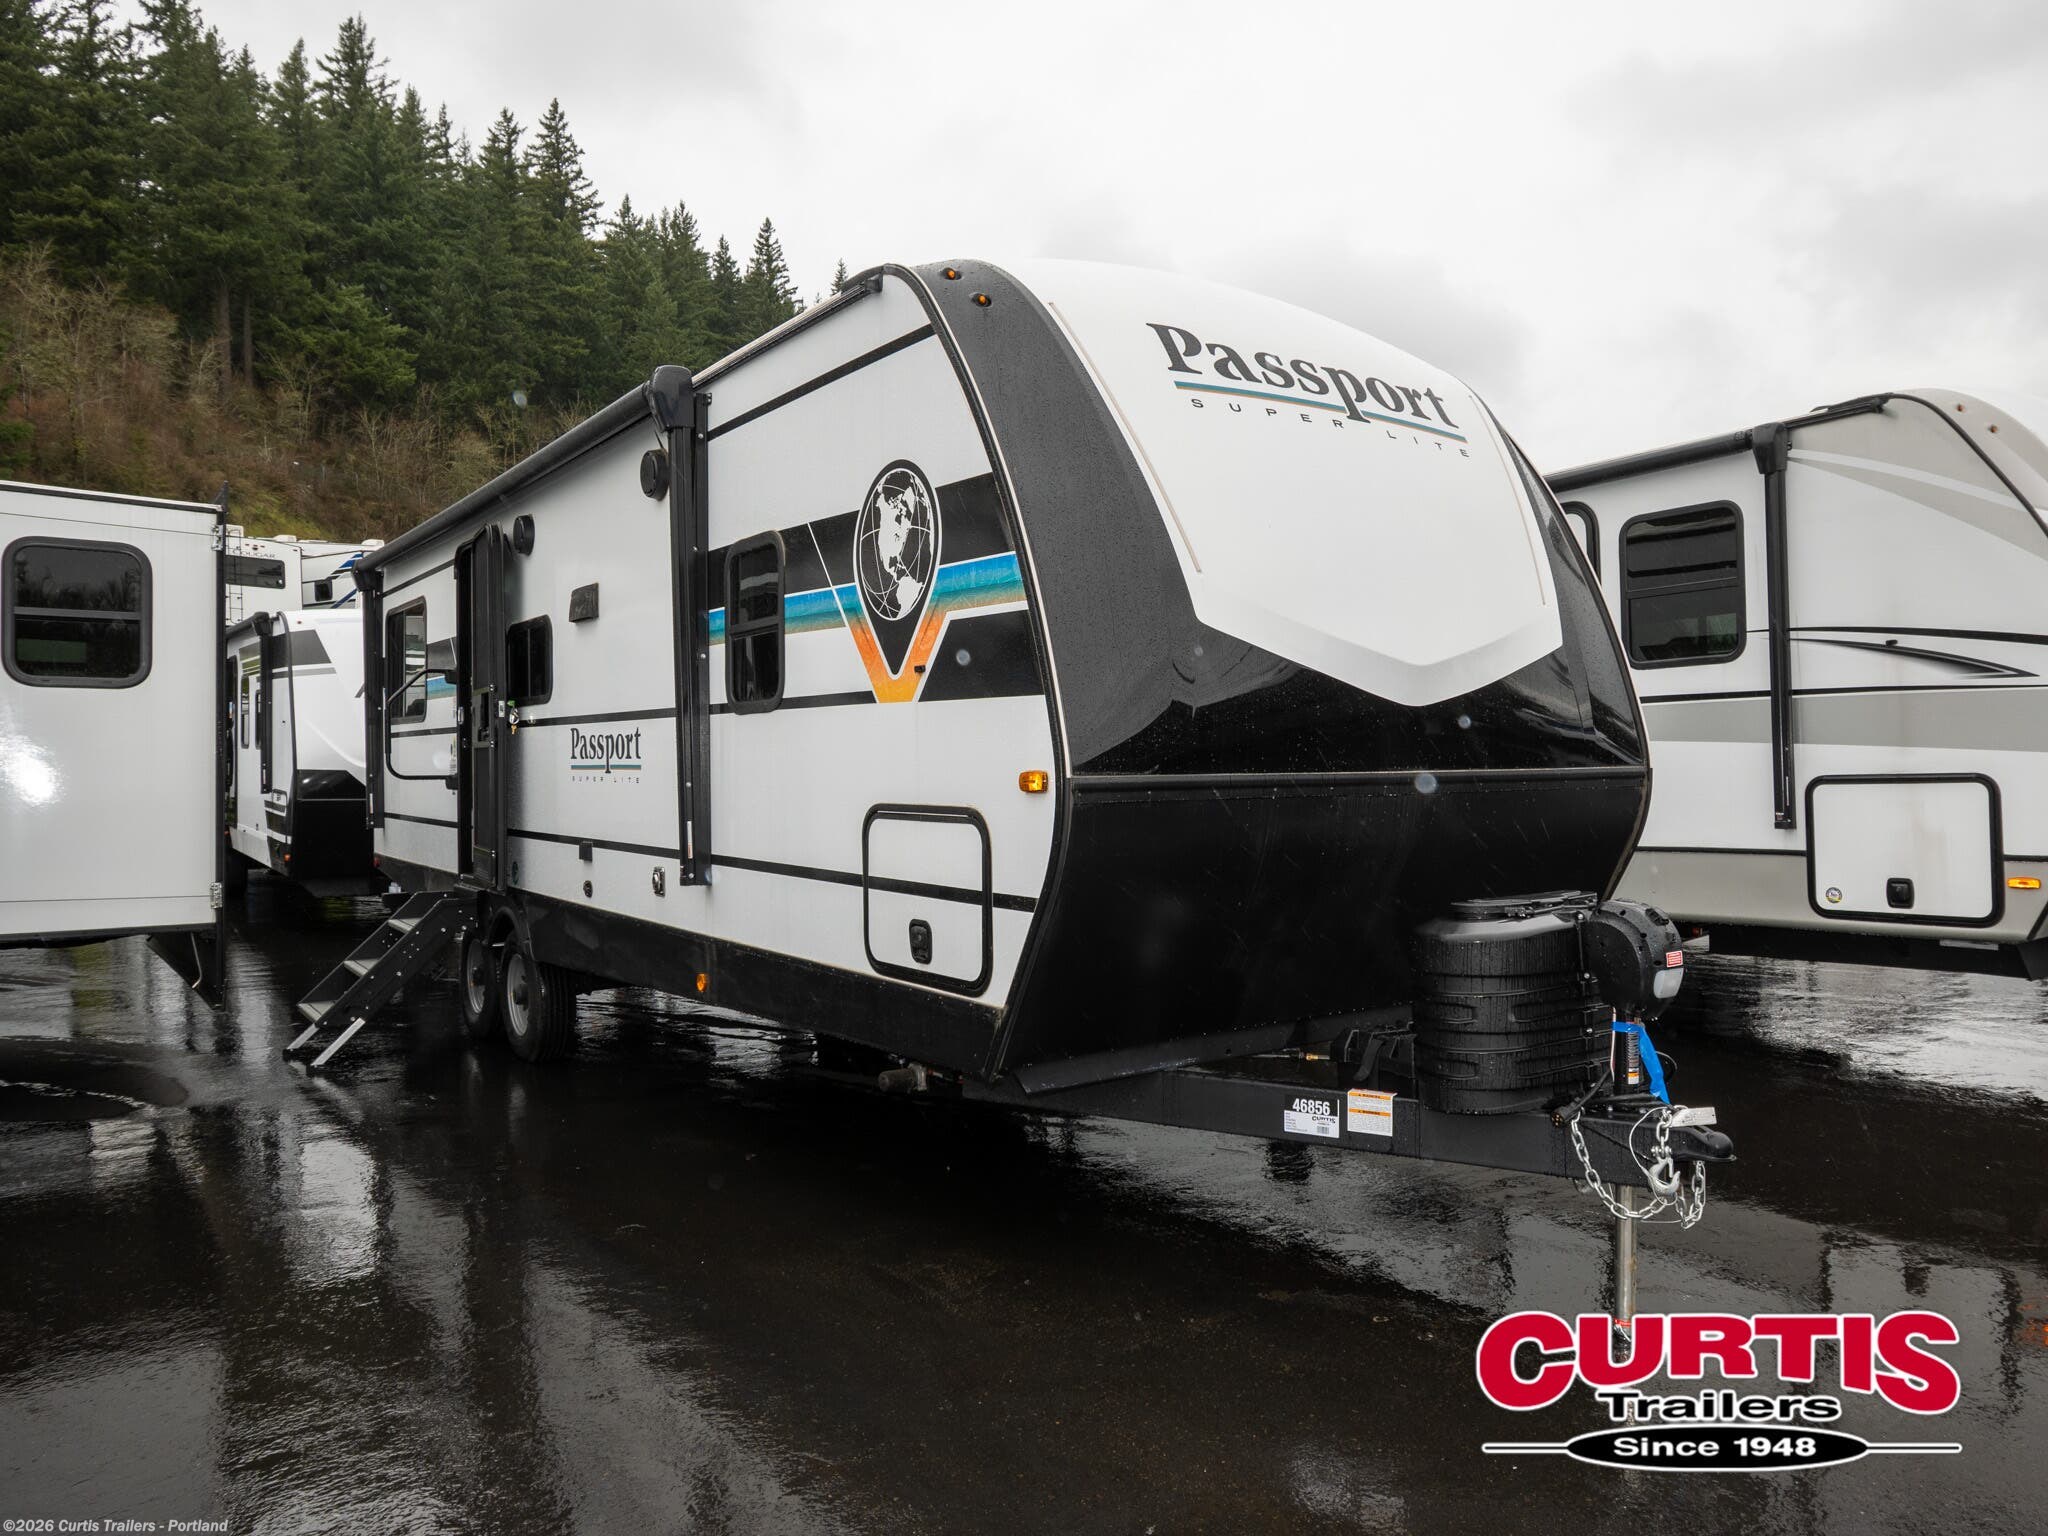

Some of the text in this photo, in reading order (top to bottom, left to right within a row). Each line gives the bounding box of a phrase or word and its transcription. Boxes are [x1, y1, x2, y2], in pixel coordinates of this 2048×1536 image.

[1145, 322, 1459, 429] Passport
[1191, 398, 1470, 458] SUPER LITE
[570, 727, 641, 774] Passport
[1292, 1098, 1330, 1115] 46856
